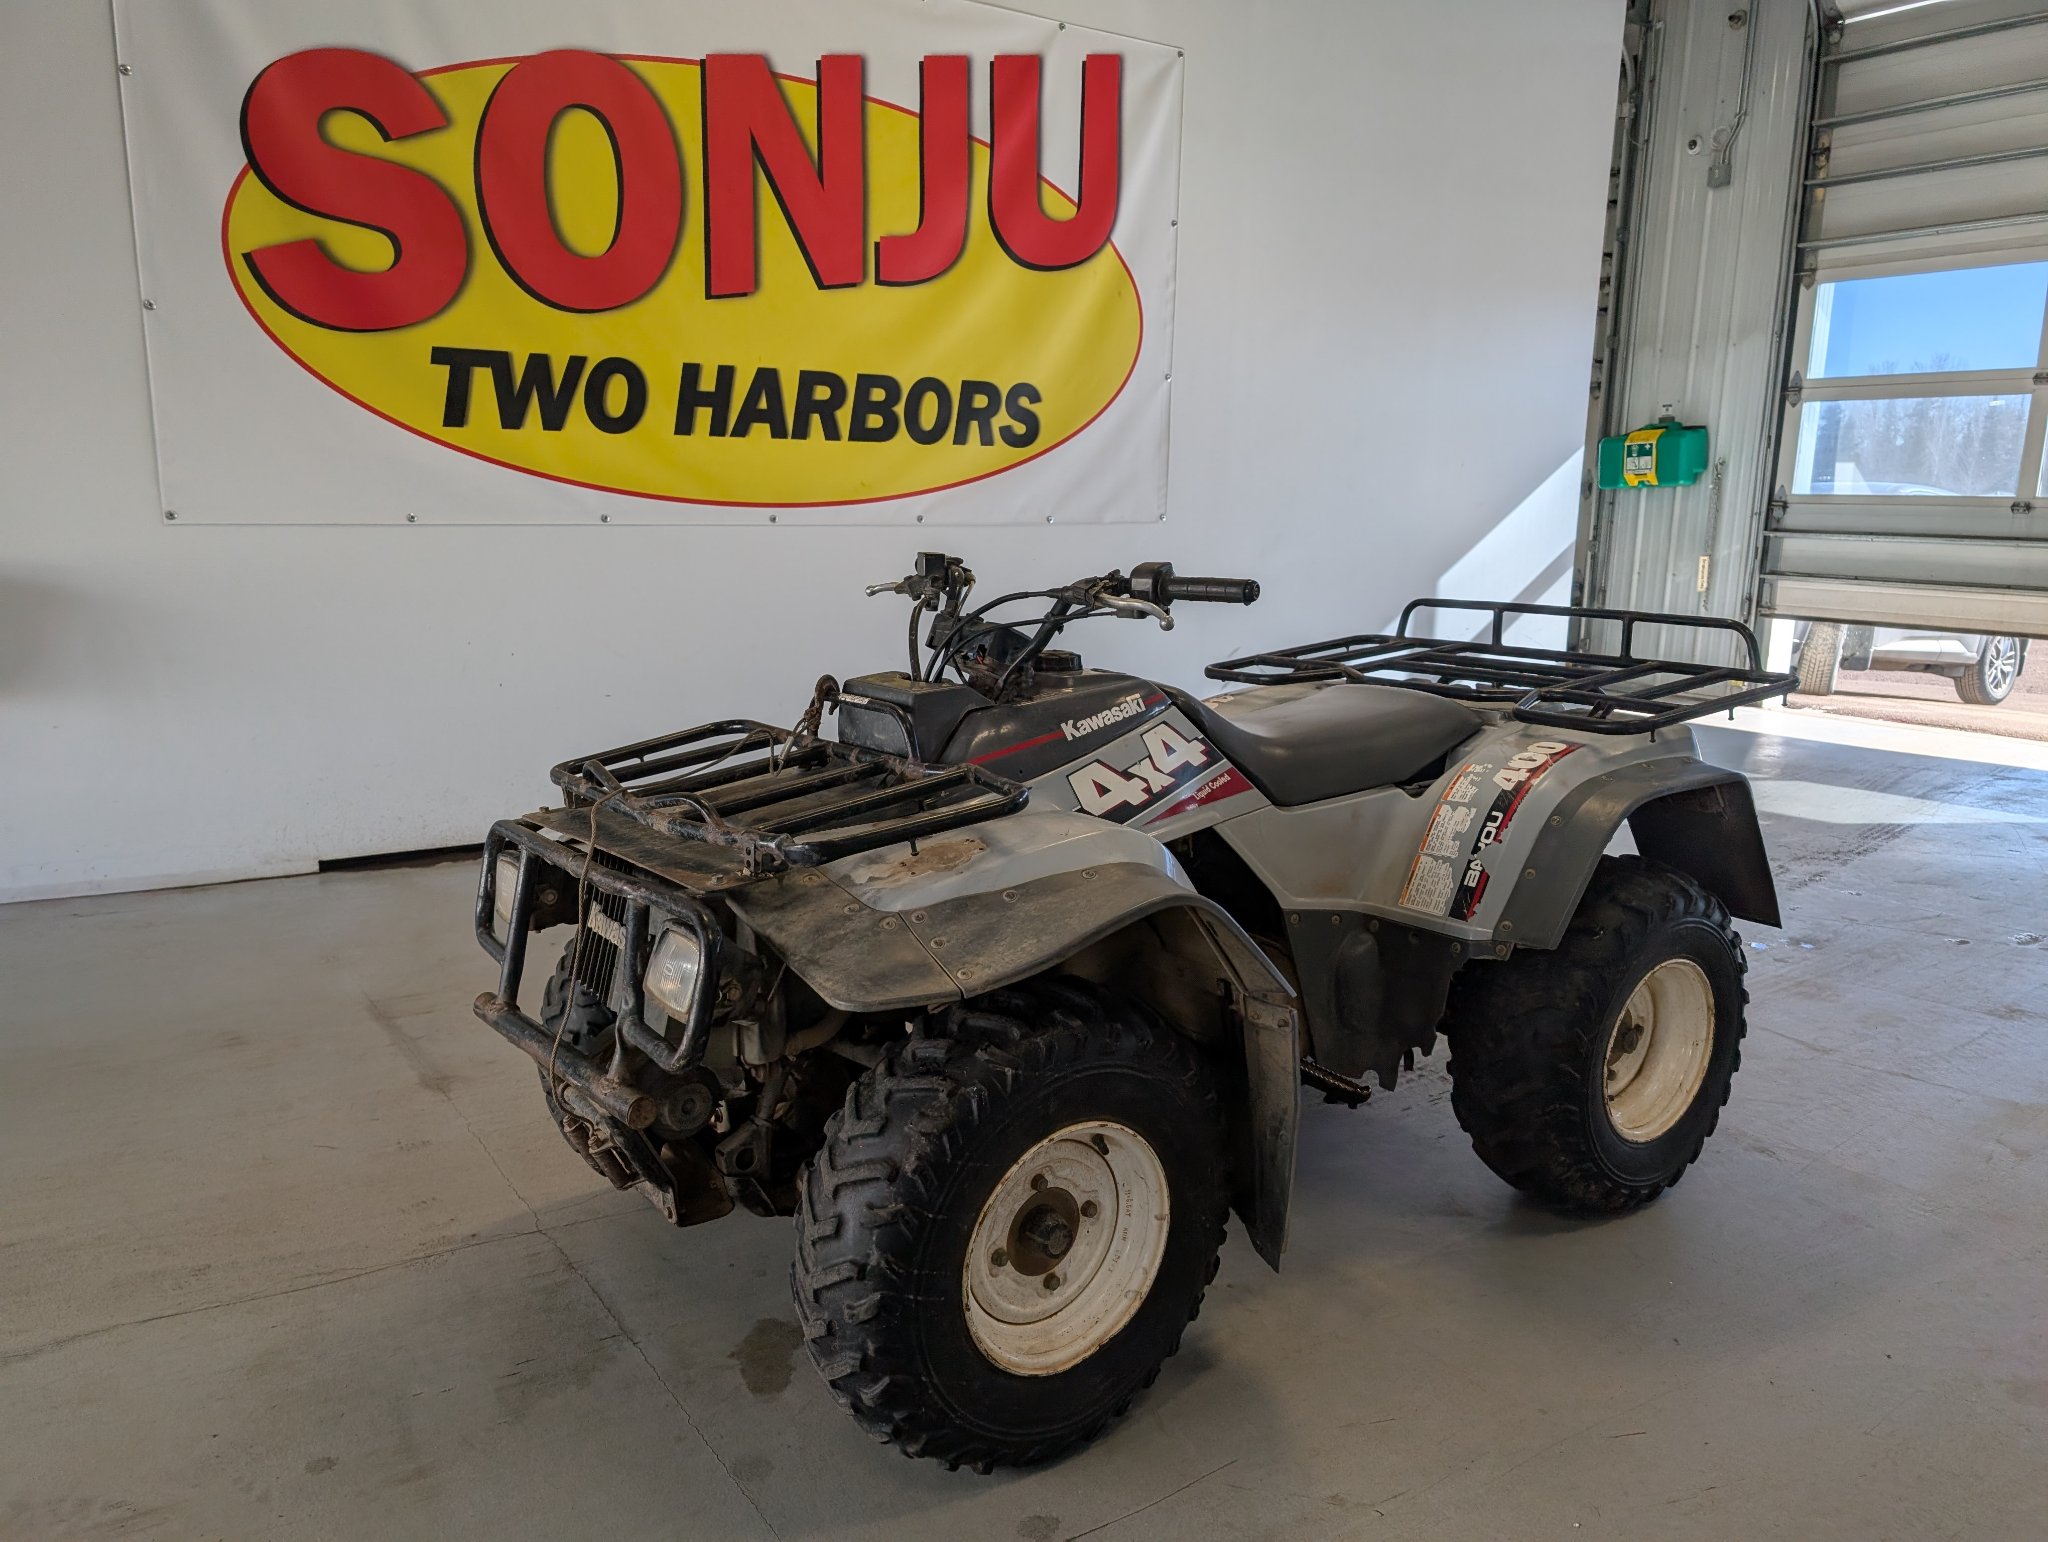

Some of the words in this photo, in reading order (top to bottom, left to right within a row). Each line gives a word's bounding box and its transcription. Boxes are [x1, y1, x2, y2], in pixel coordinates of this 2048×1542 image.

[242, 47, 1121, 333] SONJU
[430, 346, 646, 436] TWO
[672, 361, 1043, 449] HARBORS
[1061, 694, 1145, 741] Kawasaki
[1068, 721, 1208, 816] 4x4
[1192, 784, 1212, 801] Liquid
[1208, 772, 1232, 790] Cooled
[1492, 741, 1569, 791] 400
